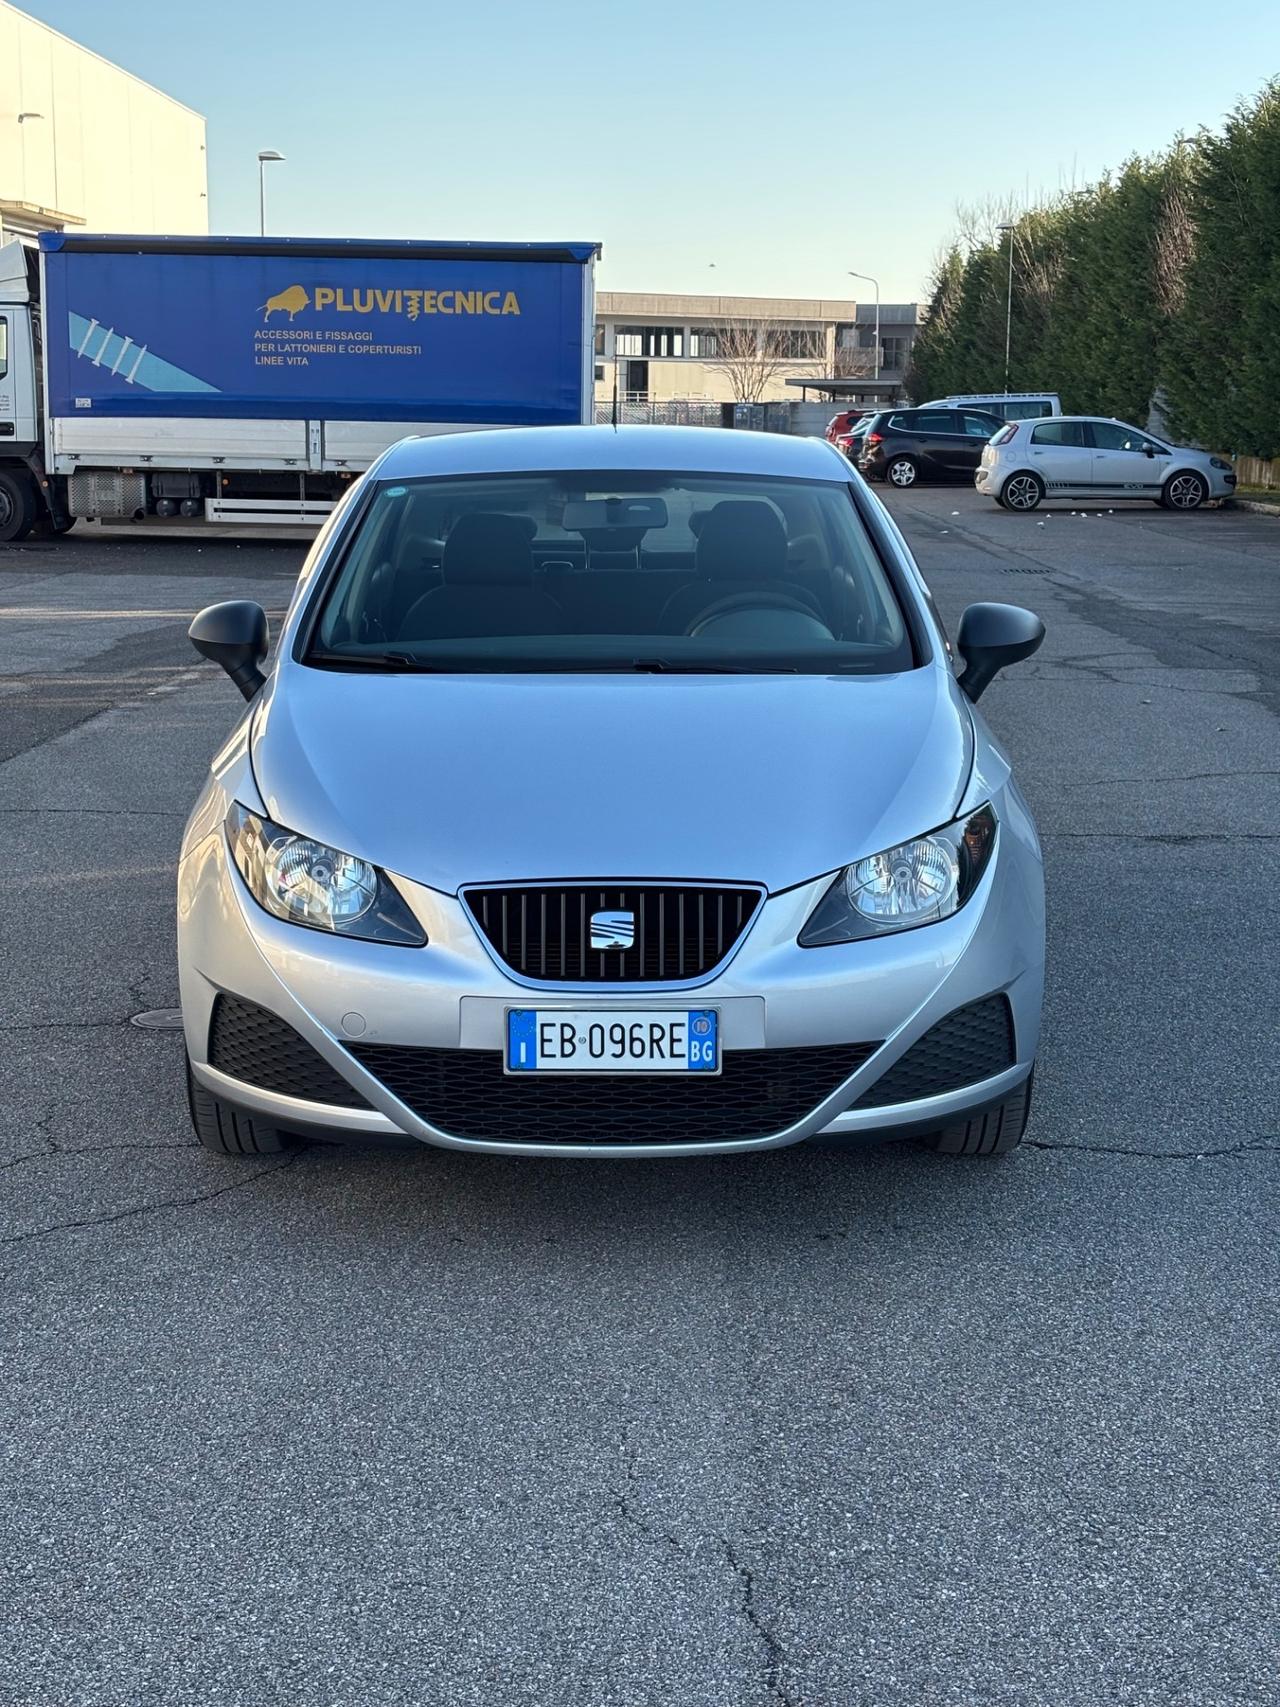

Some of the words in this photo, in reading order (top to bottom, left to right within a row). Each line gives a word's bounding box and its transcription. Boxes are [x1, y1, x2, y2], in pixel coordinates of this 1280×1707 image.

[315, 287, 521, 321] PLUVITECNICA
[254, 330, 313, 340] ACCESSORI
[316, 331, 322, 340] E
[325, 331, 373, 341] FISSAGGI
[254, 344, 275, 352] PER
[278, 344, 336, 353] LATTONIERI
[339, 345, 345, 354] E
[348, 345, 422, 355] COPERTURISTI
[255, 356, 284, 365] LINEE
[287, 357, 309, 366] VITA
[691, 1040, 713, 1062] BG
